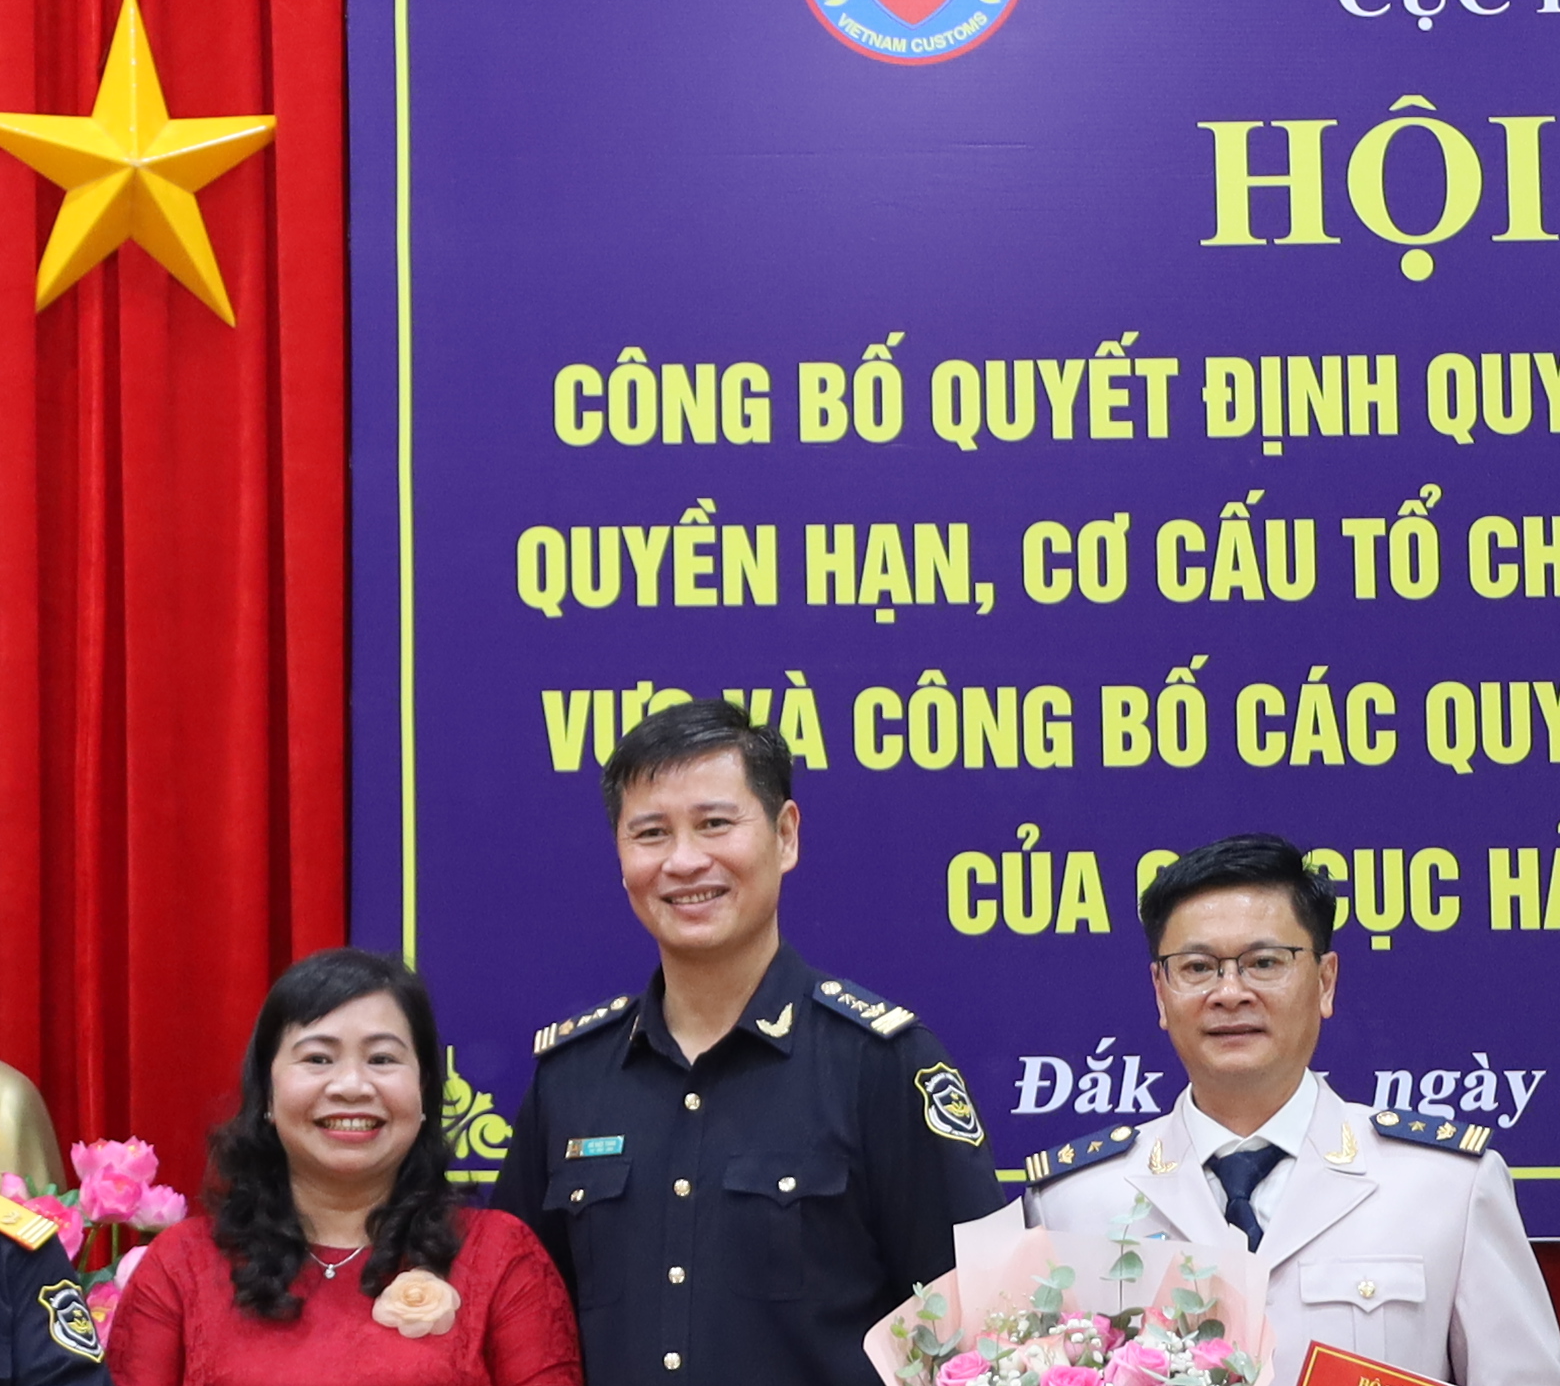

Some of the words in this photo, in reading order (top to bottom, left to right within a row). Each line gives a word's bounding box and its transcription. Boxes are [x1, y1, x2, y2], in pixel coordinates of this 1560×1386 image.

[837, 12, 907, 53] VIETNAM
[911, 11, 988, 53] CUSTOMS
[1197, 94, 1560, 282] HỘI
[554, 346, 771, 446] CÔNG
[798, 331, 905, 443] BỐ
[931, 331, 1179, 451] QUYẾT
[1202, 354, 1398, 456] ĐỊNH
[517, 498, 777, 618] QUYỀN
[805, 523, 994, 624] HẠN,
[1023, 512, 1130, 604] CƠ
[1156, 489, 1316, 603] CẤU
[1341, 483, 1442, 600] TỔ
[853, 669, 1073, 770] CÔNG
[1101, 654, 1209, 768] BỐ
[1236, 665, 1397, 767] CÁC
[947, 823, 1111, 935] CỦA
[1010, 1037, 1164, 1114] Đắk
[1373, 1052, 1547, 1127] ngày
